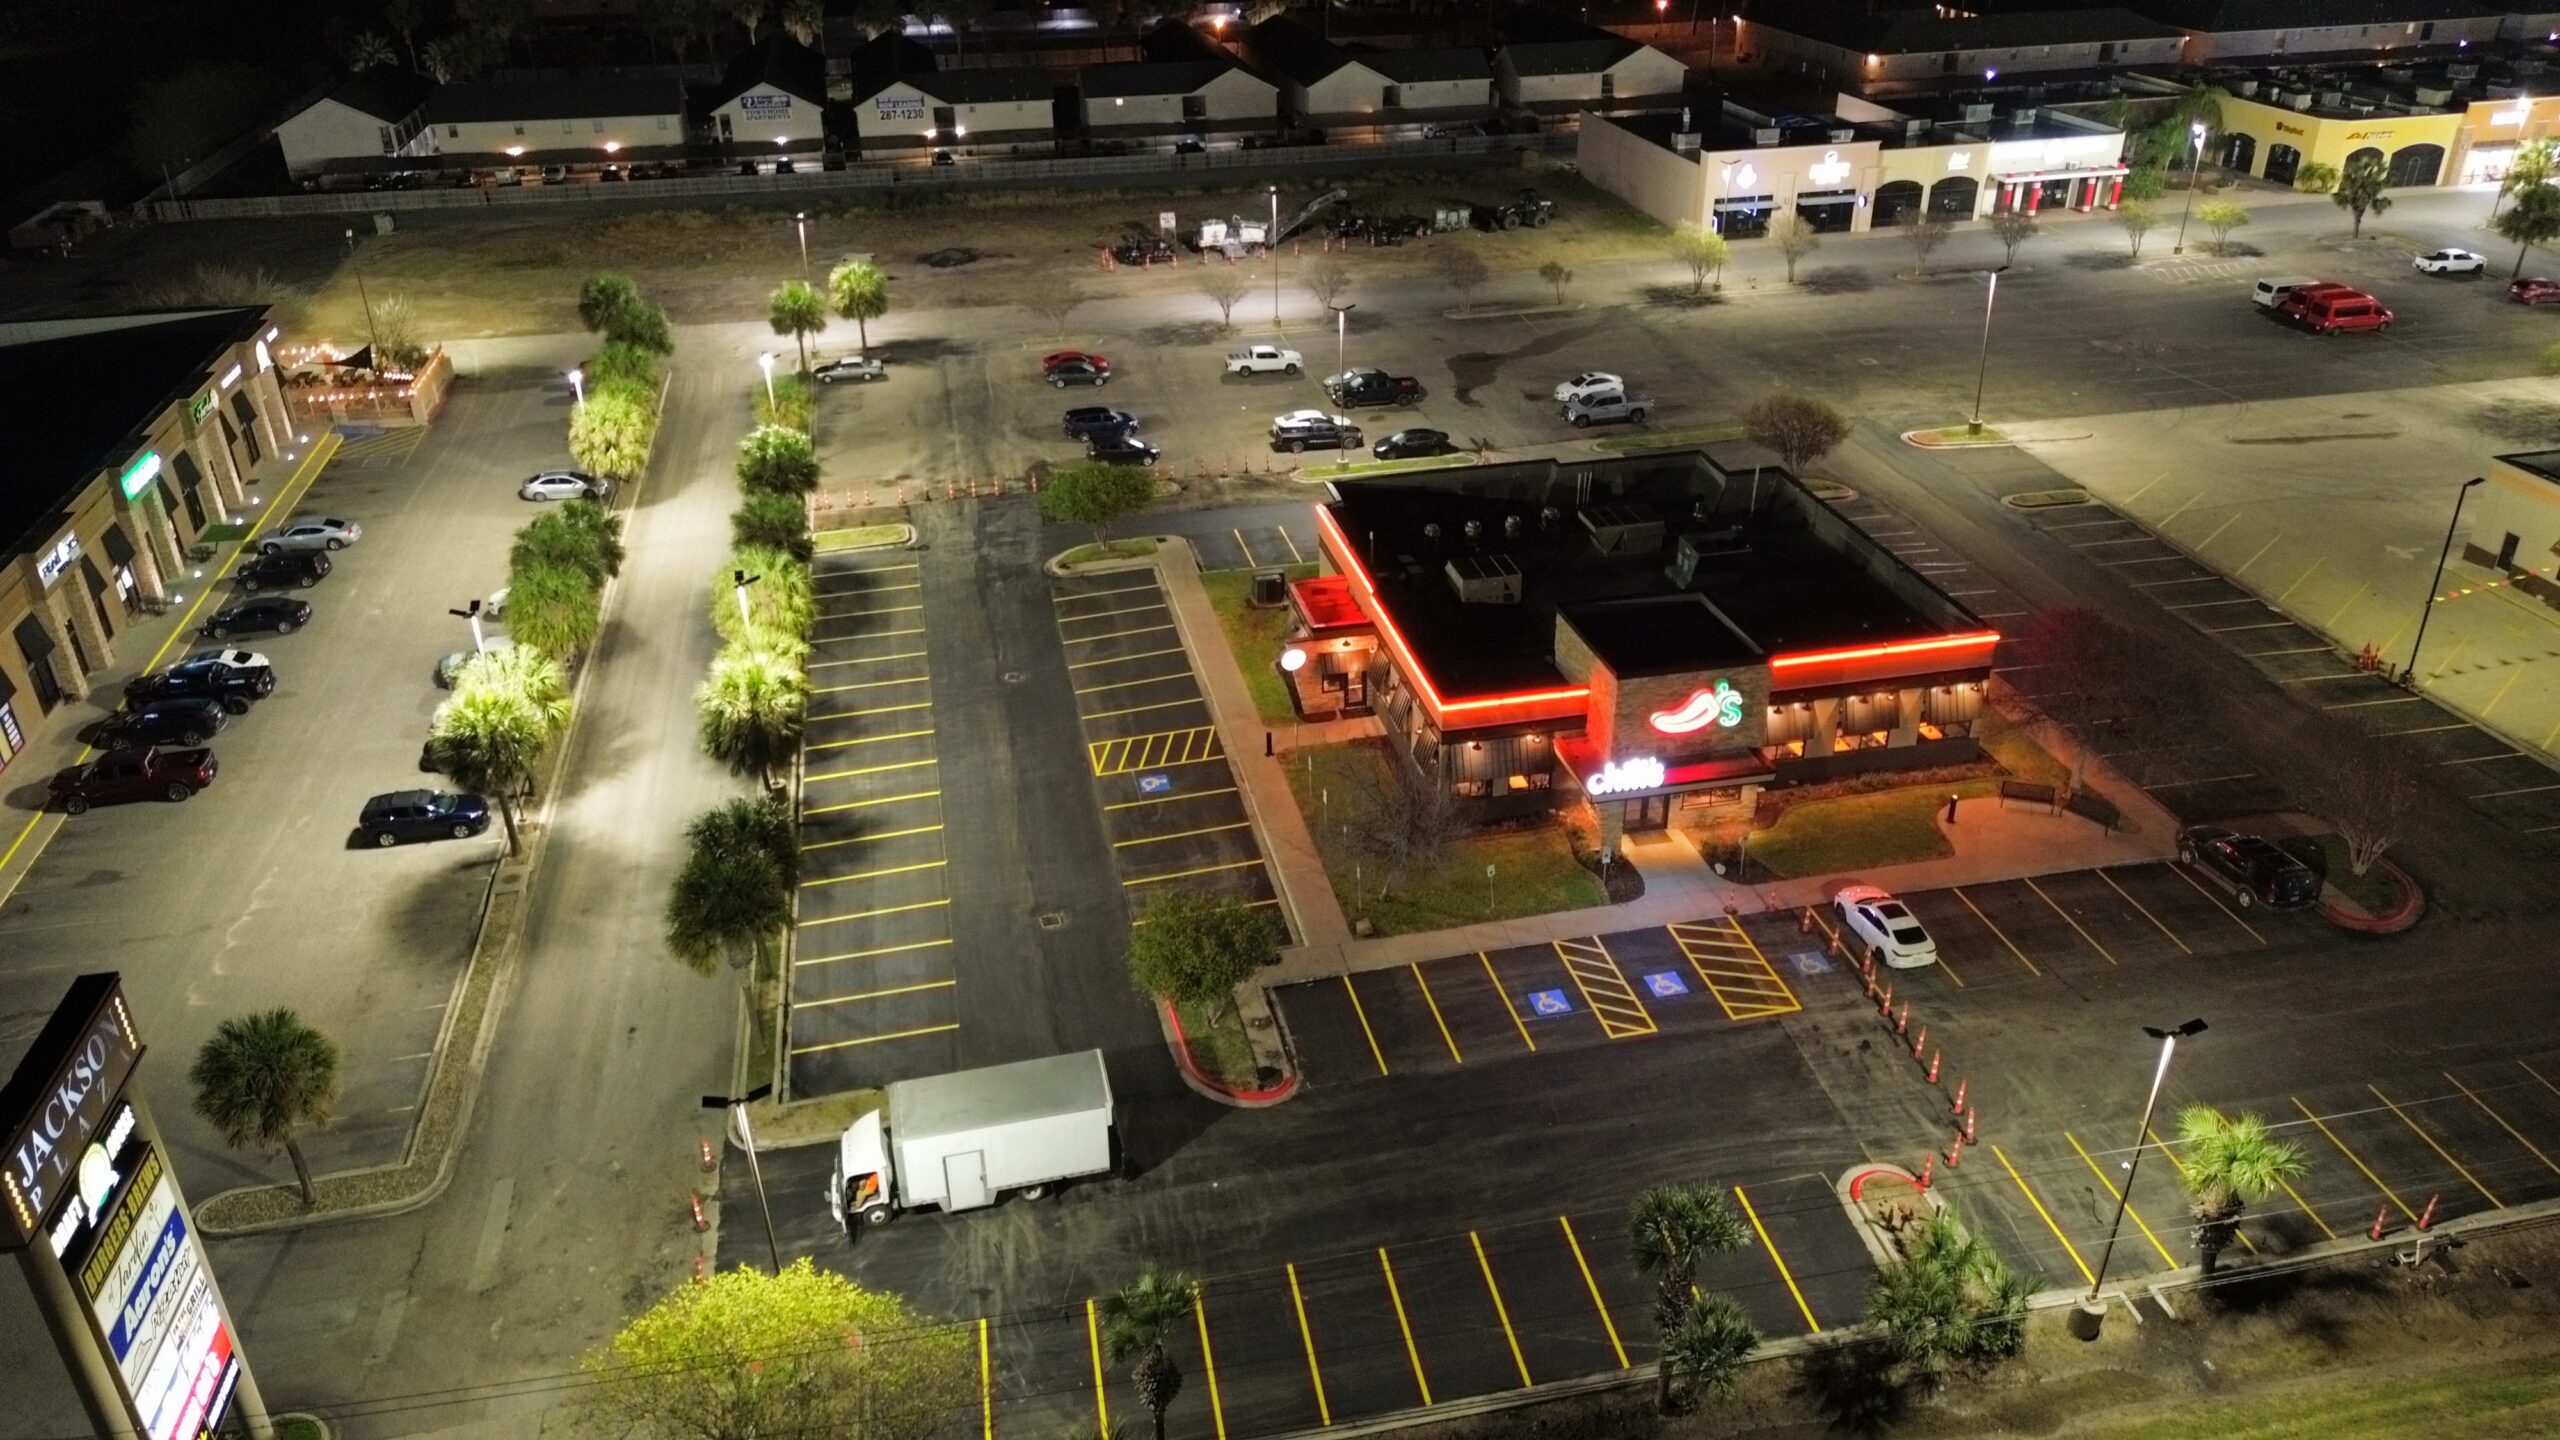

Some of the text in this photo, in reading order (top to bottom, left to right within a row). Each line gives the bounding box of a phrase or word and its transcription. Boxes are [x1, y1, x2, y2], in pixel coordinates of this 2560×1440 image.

[880, 108, 924, 120] 287-1230
[16, 1008, 120, 1188] JACKSON
[111, 1229, 149, 1310] Jardin
[124, 1230, 177, 1344] Aaron's
[186, 1276, 205, 1316] GRILL
